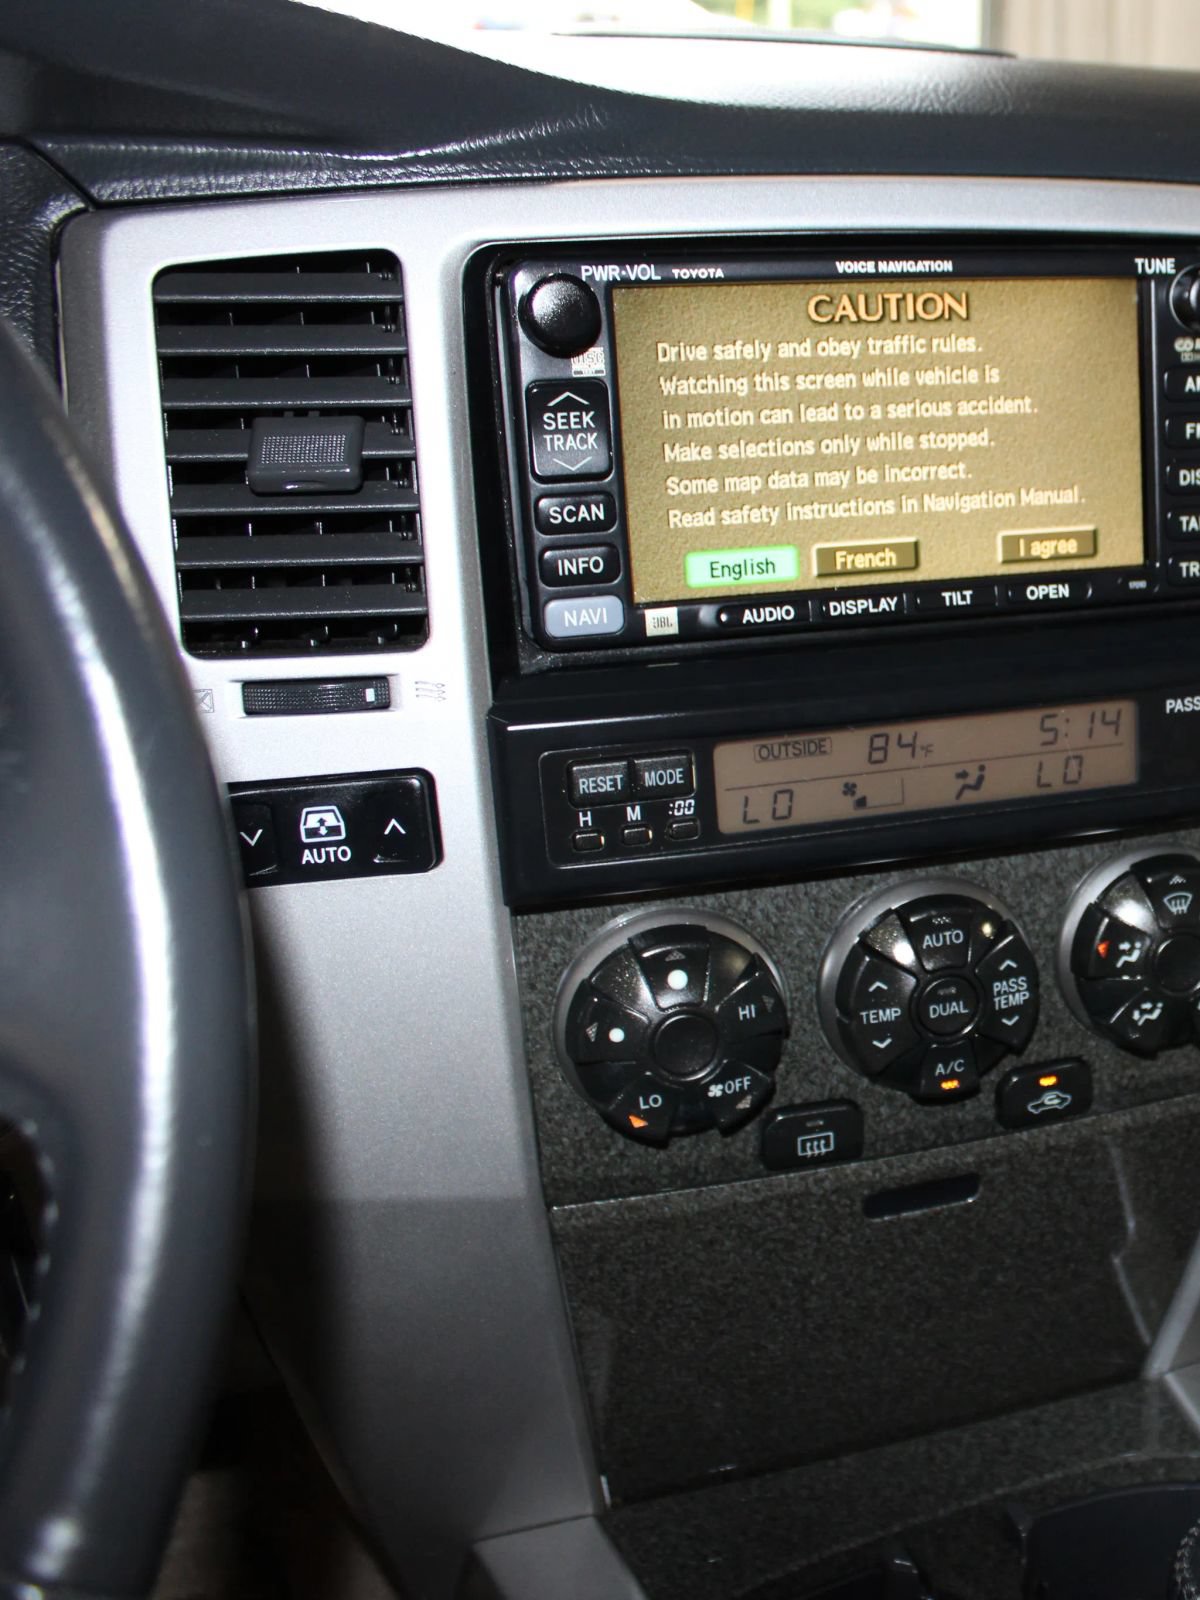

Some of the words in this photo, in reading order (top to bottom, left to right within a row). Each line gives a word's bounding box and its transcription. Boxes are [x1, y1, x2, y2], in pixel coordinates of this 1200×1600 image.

[672, 267, 724, 280] TOYOTA
[836, 261, 875, 274] VOICE
[878, 259, 952, 273] NAVIGATION
[1135, 257, 1176, 275] TUNE
[808, 291, 969, 323] CAUTION
[657, 341, 707, 362] Drive
[713, 339, 771, 362] safely
[778, 337, 811, 358] and
[817, 336, 861, 359] obey
[867, 333, 926, 355] traffic
[932, 332, 982, 353] rules.
[660, 374, 748, 396] Watching
[754, 371, 790, 391] this
[796, 371, 856, 390] screen
[862, 367, 910, 387] while
[915, 364, 979, 384] vehicle
[985, 363, 1000, 383] is
[542, 411, 596, 430] SEEK
[662, 409, 681, 429] in
[687, 407, 753, 428] motion
[760, 408, 793, 424] can
[799, 402, 838, 422] lead
[844, 402, 864, 420] to
[870, 405, 882, 419] a
[887, 397, 952, 417] serious
[957, 395, 1038, 416] accident.
[543, 432, 599, 452] TRACK
[664, 440, 712, 462] Make
[718, 437, 815, 460] selections
[821, 433, 860, 456] only
[866, 431, 914, 450] while
[919, 428, 995, 451] stopped.
[666, 475, 718, 495] Some
[724, 474, 761, 494] map
[767, 469, 809, 489] data
[814, 468, 850, 489] may
[856, 465, 878, 484] be
[884, 461, 973, 482] incorrect.
[549, 503, 605, 524] SCAN
[668, 506, 715, 528] Read
[721, 503, 780, 525] safety
[786, 497, 895, 520] instructions
[901, 494, 918, 513] in
[923, 487, 1015, 513] Navigation
[1020, 484, 1086, 506] Manual.
[835, 548, 896, 570] French
[1019, 538, 1025, 557] I
[1030, 537, 1078, 561] agree
[557, 556, 604, 577] INFO
[709, 556, 777, 581] English
[941, 590, 973, 607] TILT
[1026, 583, 1070, 601] OPEN
[563, 602, 608, 626] NAVI
[742, 605, 795, 624] AUDIO
[829, 596, 898, 616] DISPLAY
[1040, 708, 1122, 746] 5:14
[757, 738, 828, 762] OUTSIDE
[644, 767, 684, 787] MODE
[1036, 754, 1084, 789] LO
[579, 774, 624, 793] RESET
[626, 805, 642, 822] M
[743, 788, 795, 825] LO
[578, 811, 592, 827] H
[301, 845, 351, 864] AUTO
[922, 930, 964, 949] AUTO
[993, 977, 1028, 996] PASS
[928, 1000, 970, 1019] DUAL
[993, 991, 1030, 1011] TEMP
[738, 1005, 756, 1021] HI
[859, 1007, 901, 1025] TEMP
[935, 1059, 965, 1077] A/C
[724, 1076, 751, 1095] OFF
[639, 1094, 662, 1110] LO
